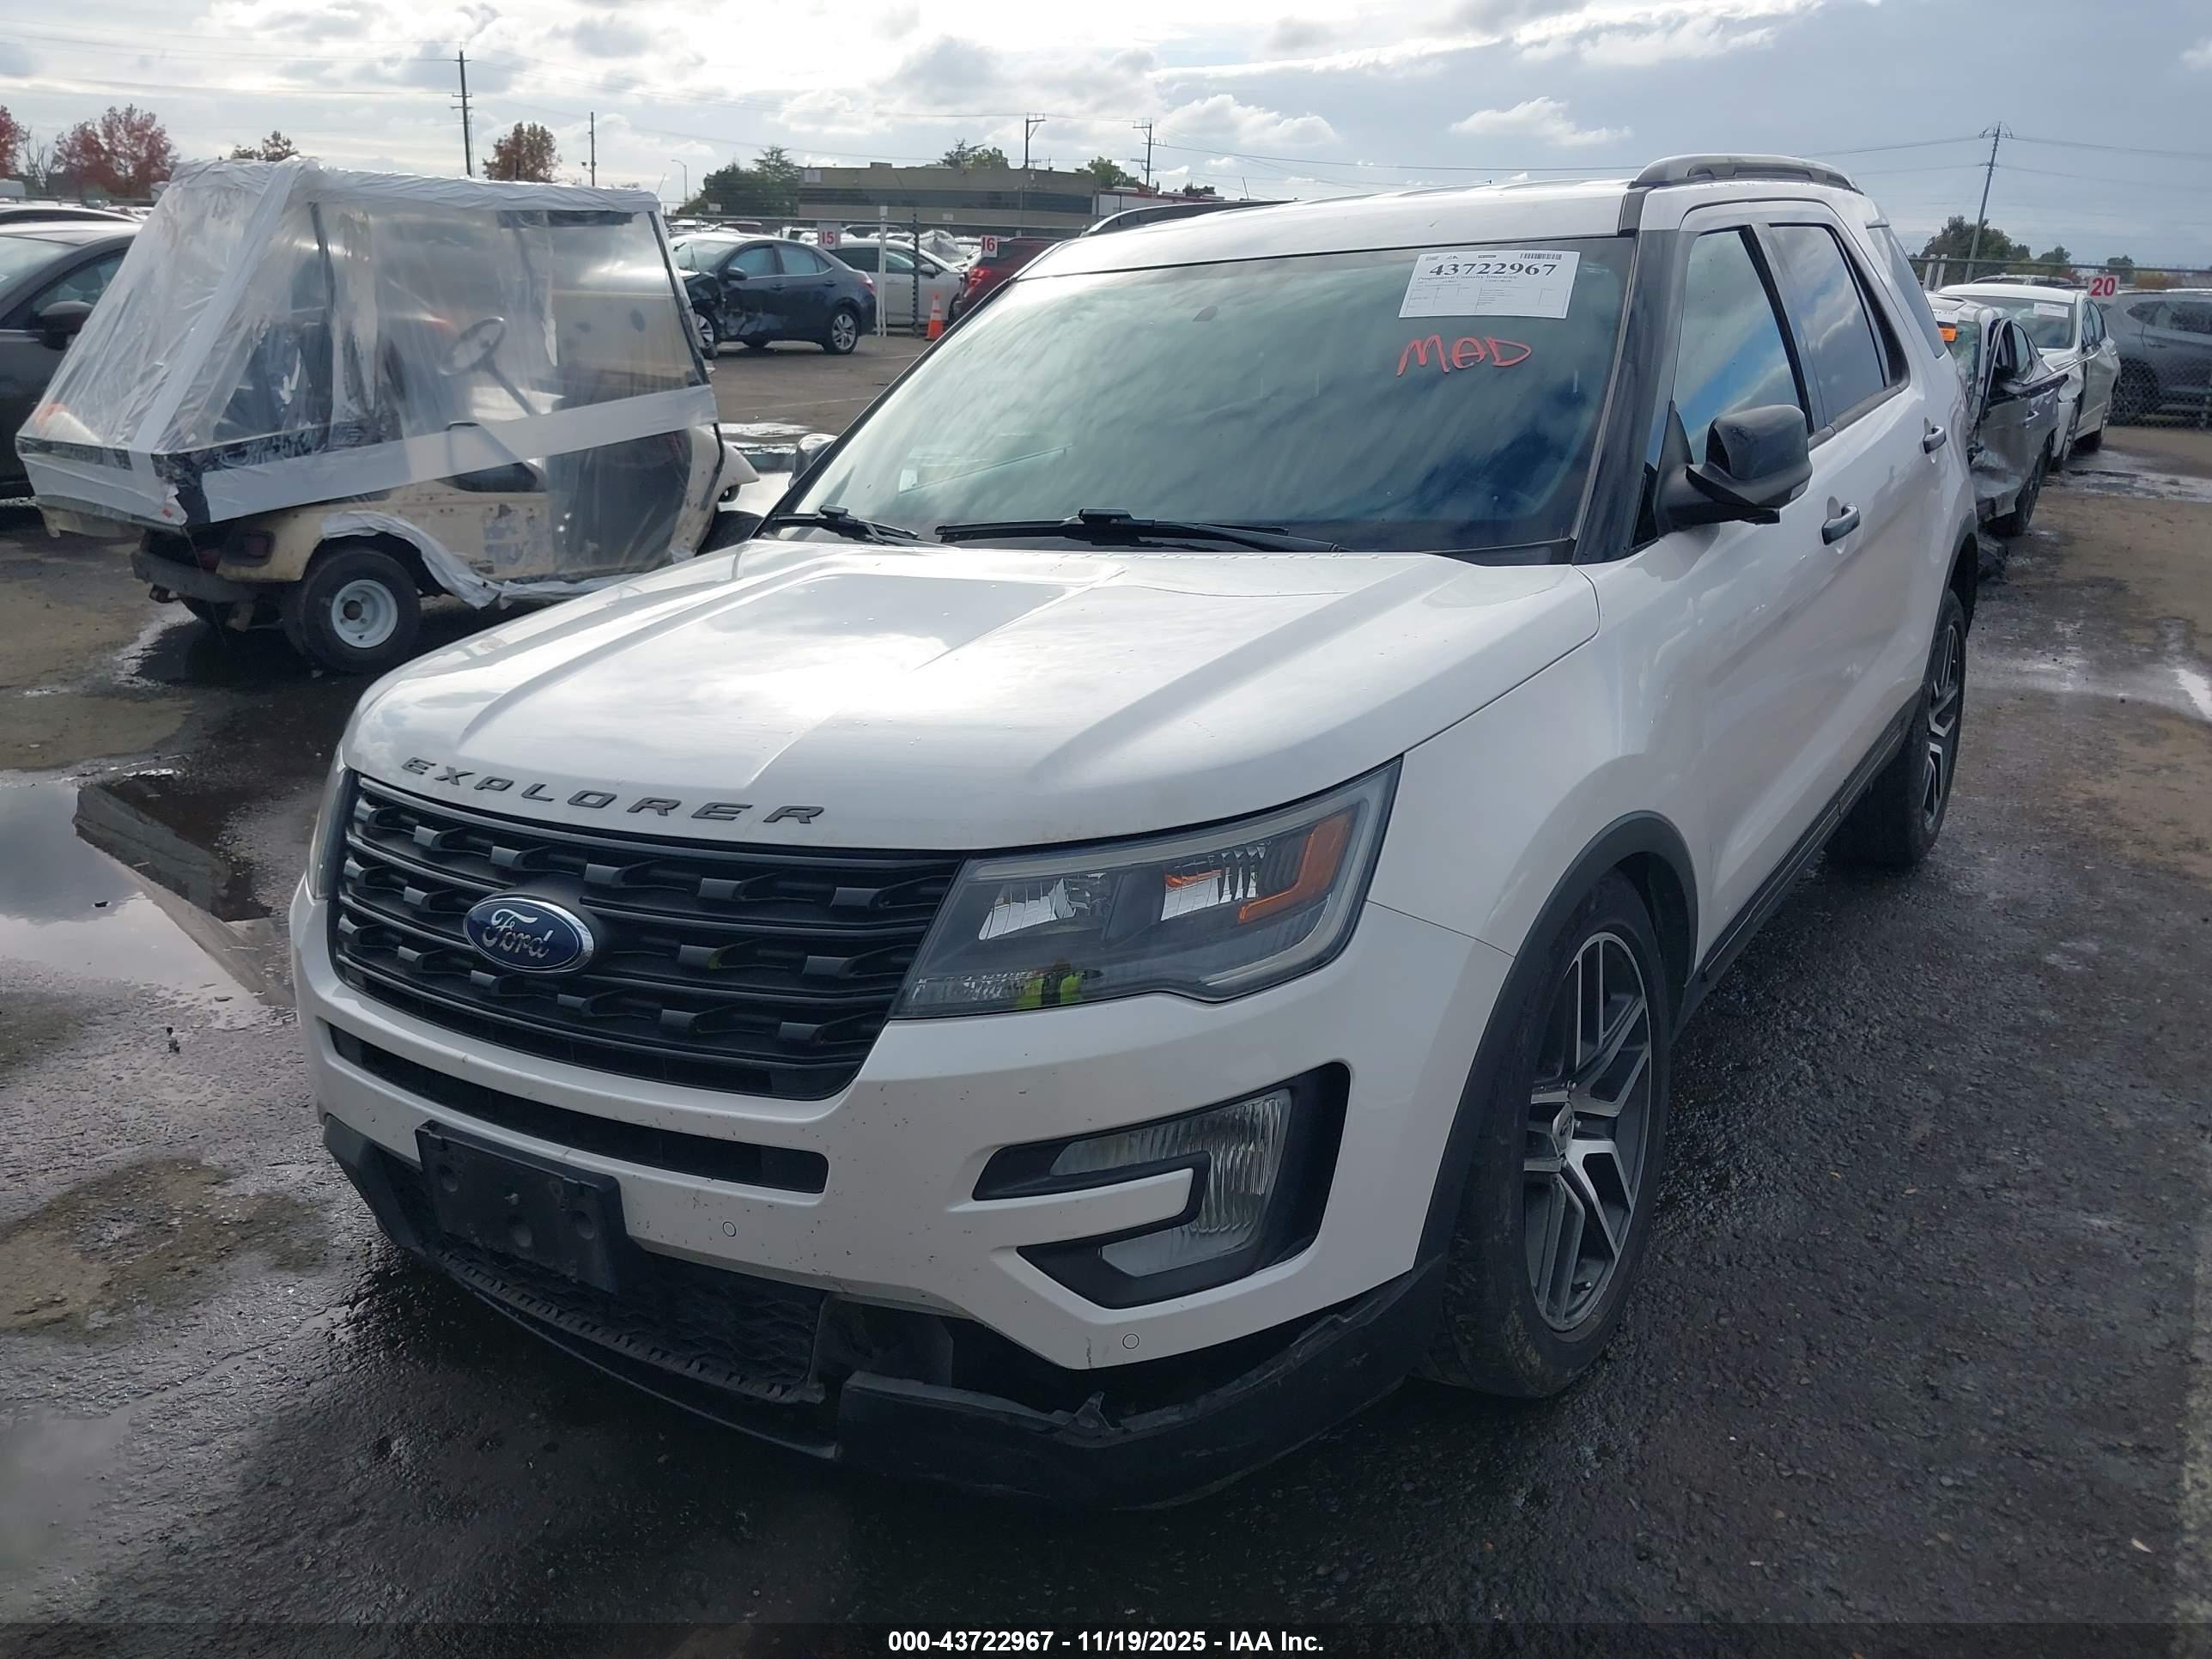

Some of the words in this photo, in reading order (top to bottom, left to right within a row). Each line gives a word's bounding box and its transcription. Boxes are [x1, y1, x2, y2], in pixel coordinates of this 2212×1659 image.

[822, 231, 835, 245] 15
[982, 236, 995, 252] 16
[1429, 262, 1558, 276] 43722967
[2090, 277, 2116, 296] 20
[401, 757, 824, 823] EXPLORER
[482, 908, 554, 958] Ford
